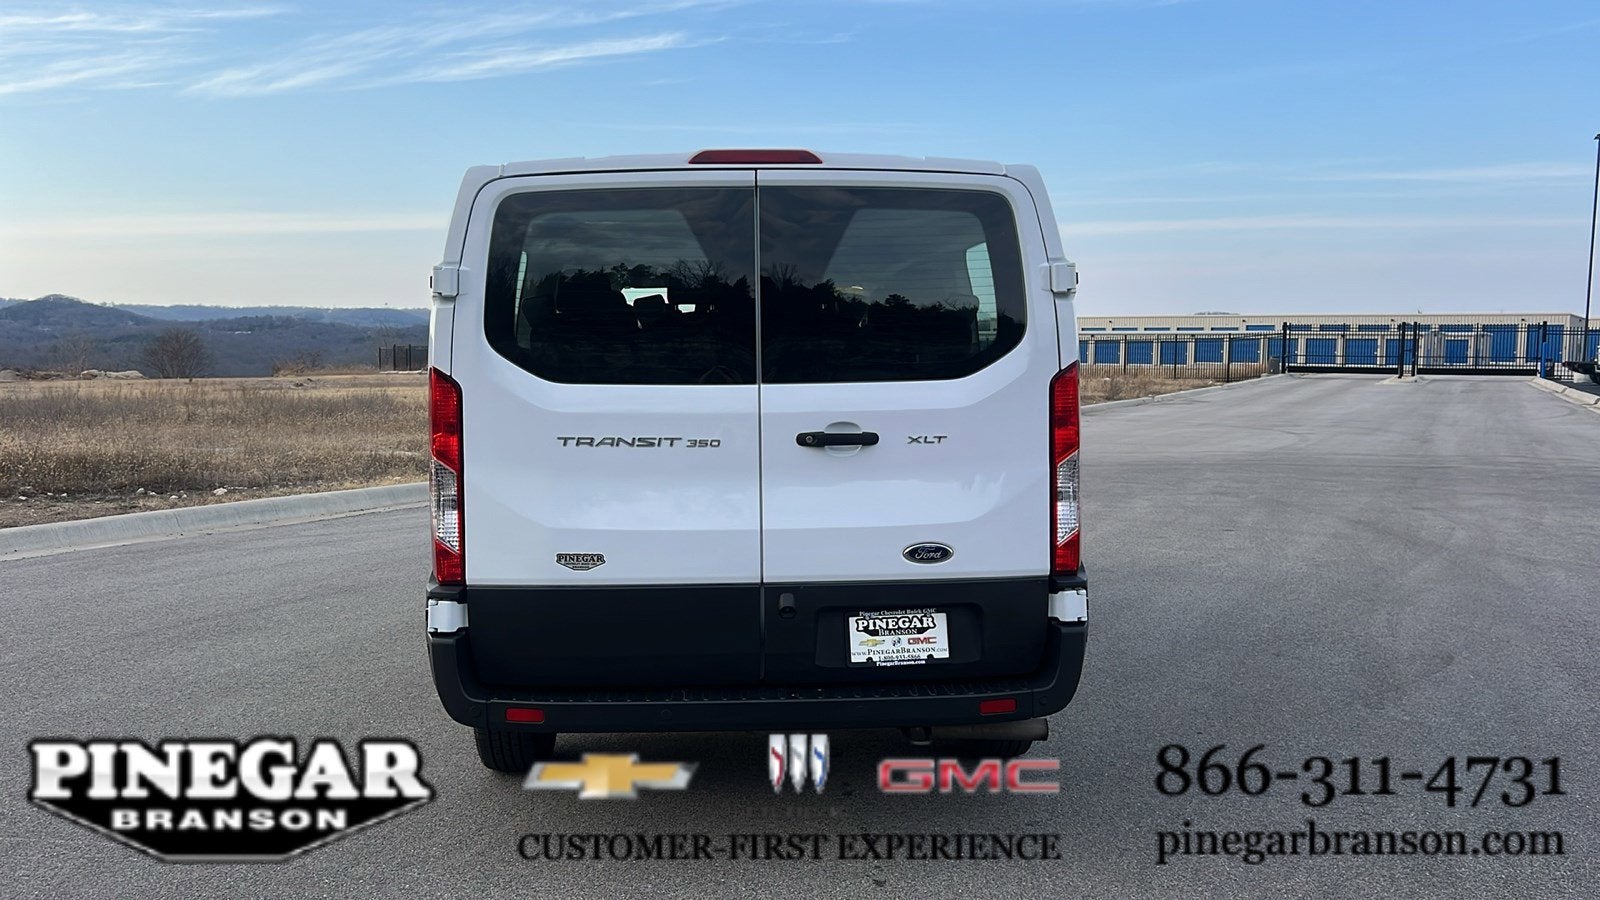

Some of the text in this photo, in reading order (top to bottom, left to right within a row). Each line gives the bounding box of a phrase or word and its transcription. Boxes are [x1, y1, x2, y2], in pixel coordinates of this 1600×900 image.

[557, 436, 721, 448] TRANSIT 350
[907, 435, 948, 445] XLT
[915, 547, 942, 559] Ford
[557, 554, 604, 563] PINEGAR
[857, 616, 935, 631] PINEGAR
[878, 628, 918, 636] BRANSON
[907, 636, 937, 646] GMC
